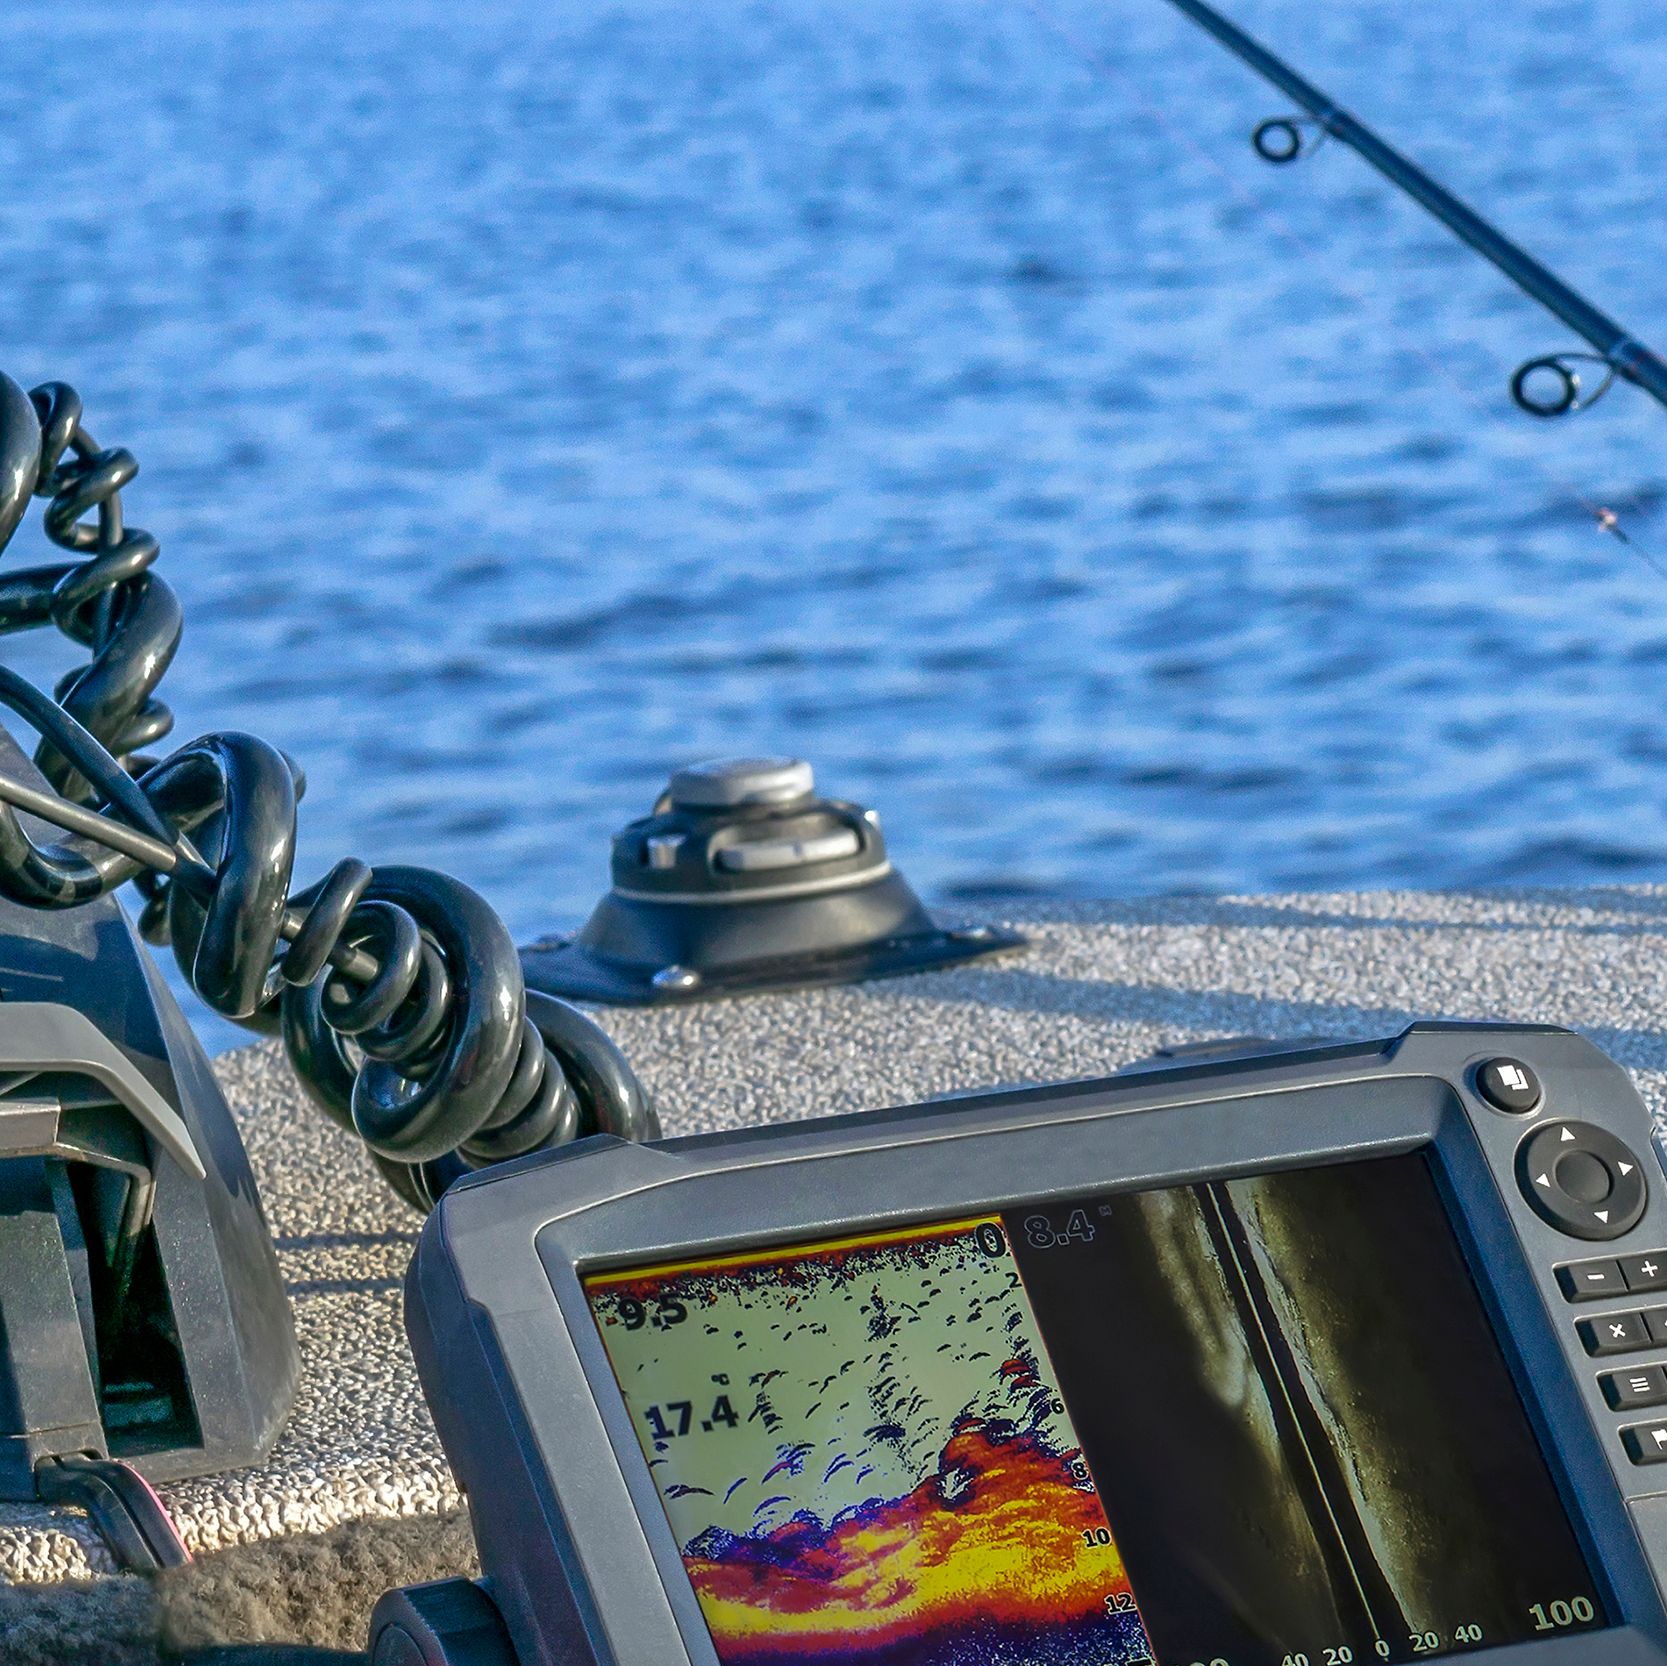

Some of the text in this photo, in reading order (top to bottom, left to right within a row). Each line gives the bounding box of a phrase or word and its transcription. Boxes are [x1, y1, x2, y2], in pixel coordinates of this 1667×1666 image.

[974, 1221, 1008, 1259] 0
[1024, 1210, 1096, 1249] 8.4
[1005, 1272, 1022, 1288] 2
[617, 1292, 688, 1331] 9.5
[644, 1395, 740, 1440] 17.4
[1051, 1398, 1065, 1414] 6
[1072, 1461, 1088, 1479] 8
[1082, 1527, 1111, 1548] 10
[1105, 1593, 1137, 1614] 12
[1322, 1646, 1353, 1666] 20
[1374, 1639, 1390, 1657] 0
[1409, 1631, 1440, 1652] 20
[1454, 1623, 1483, 1643] 40
[1528, 1596, 1595, 1631] 100
